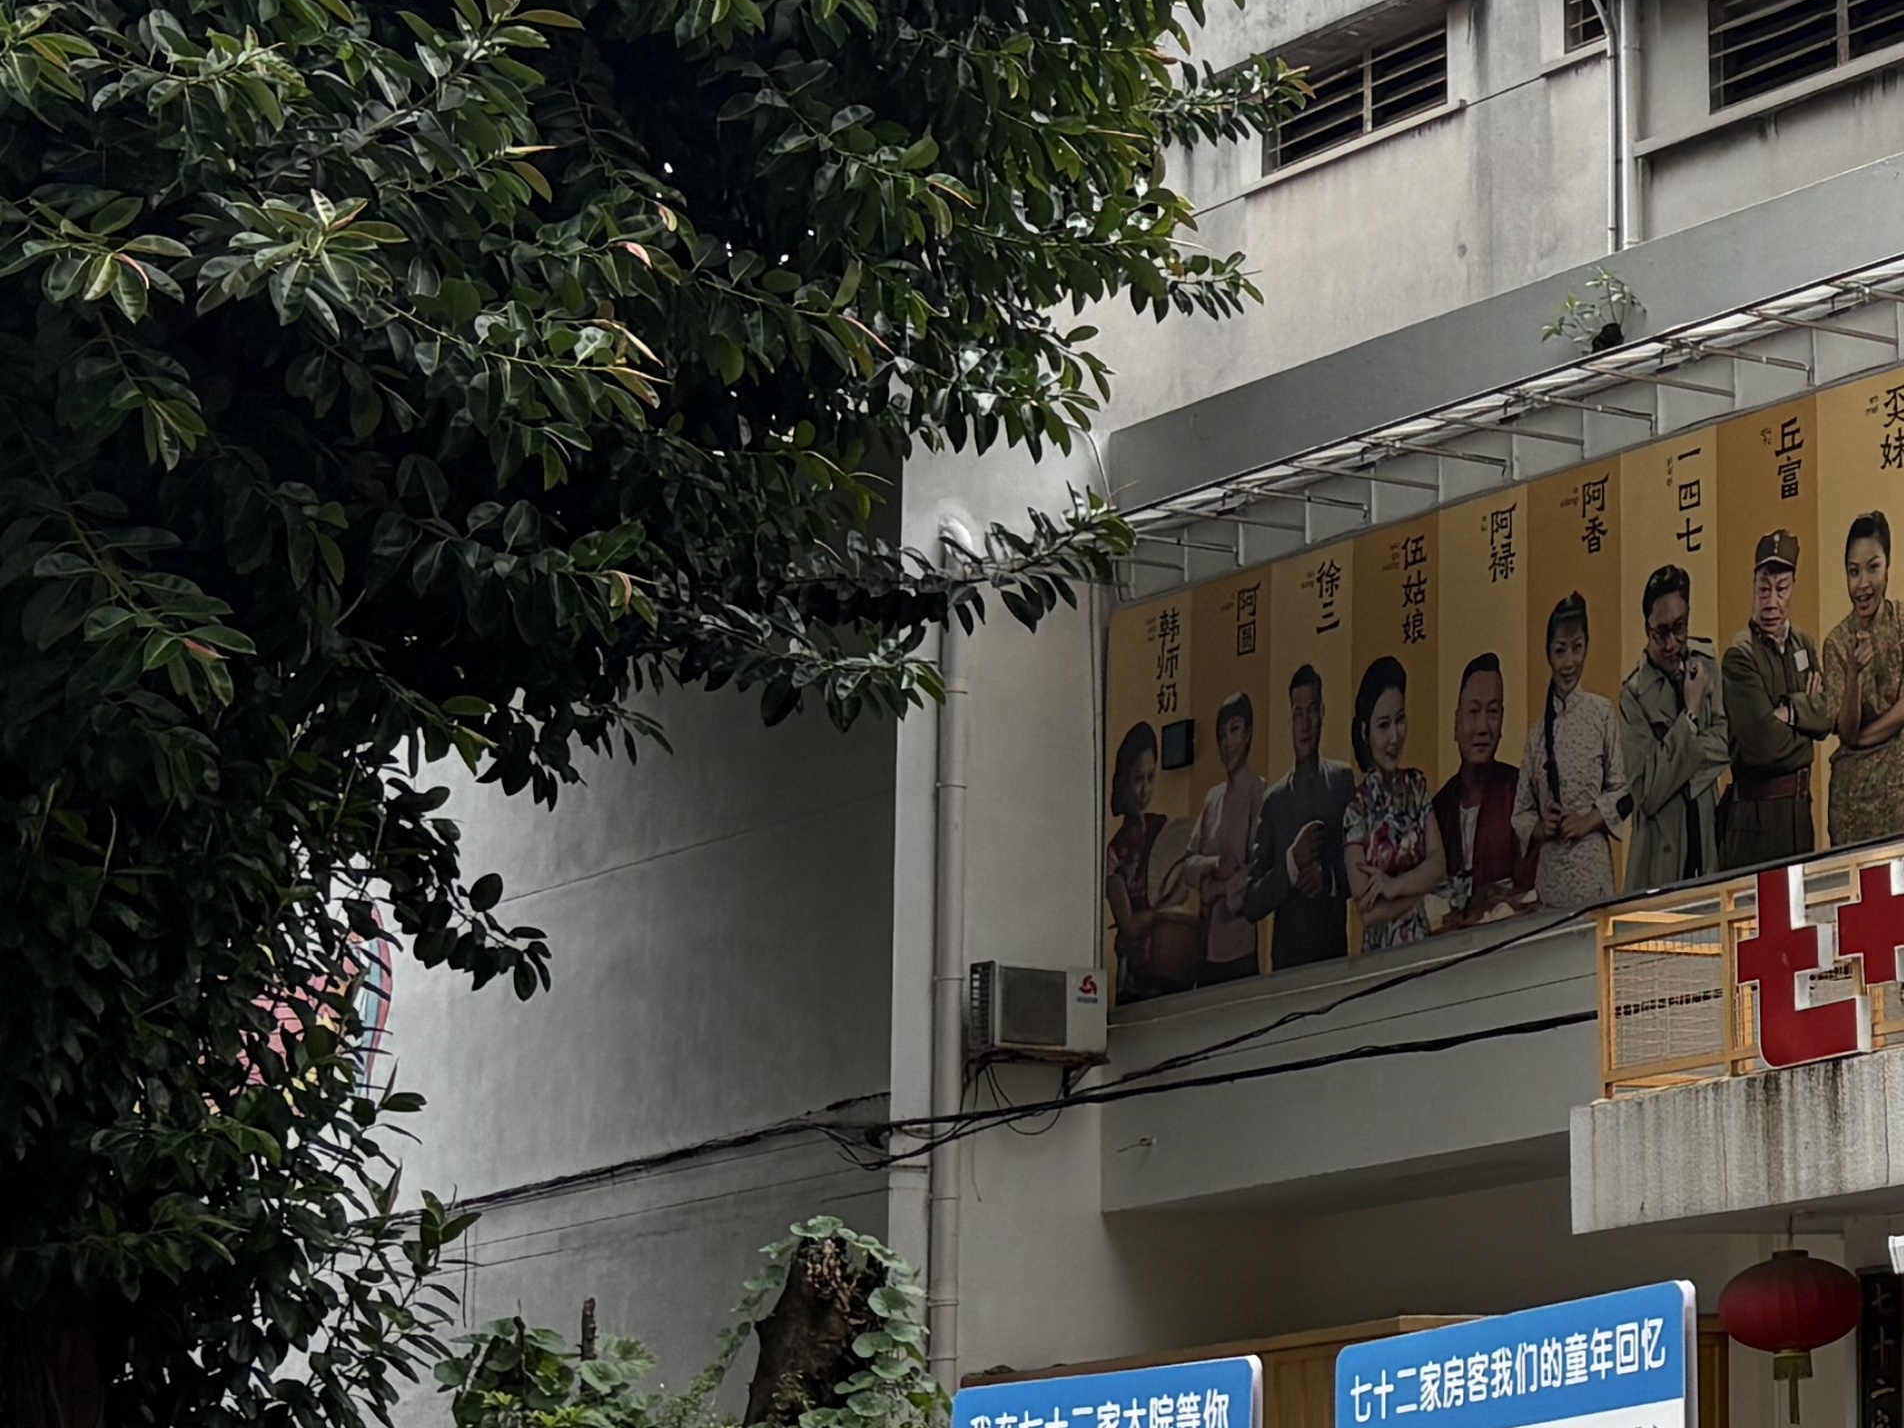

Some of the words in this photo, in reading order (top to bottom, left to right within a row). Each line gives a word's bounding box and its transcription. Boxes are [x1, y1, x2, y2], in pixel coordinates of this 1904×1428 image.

[1677, 447, 1703, 554] 一四七
[1774, 417, 1804, 500] 丘富
[1488, 503, 1517, 583] 阿禄
[1581, 473, 1610, 555] 阿香
[1401, 535, 1428, 645] 伍姑娘
[1156, 607, 1180, 715] 韩师奶
[1350, 1317, 1667, 1421] 七十二家房客我们的童年回忆
